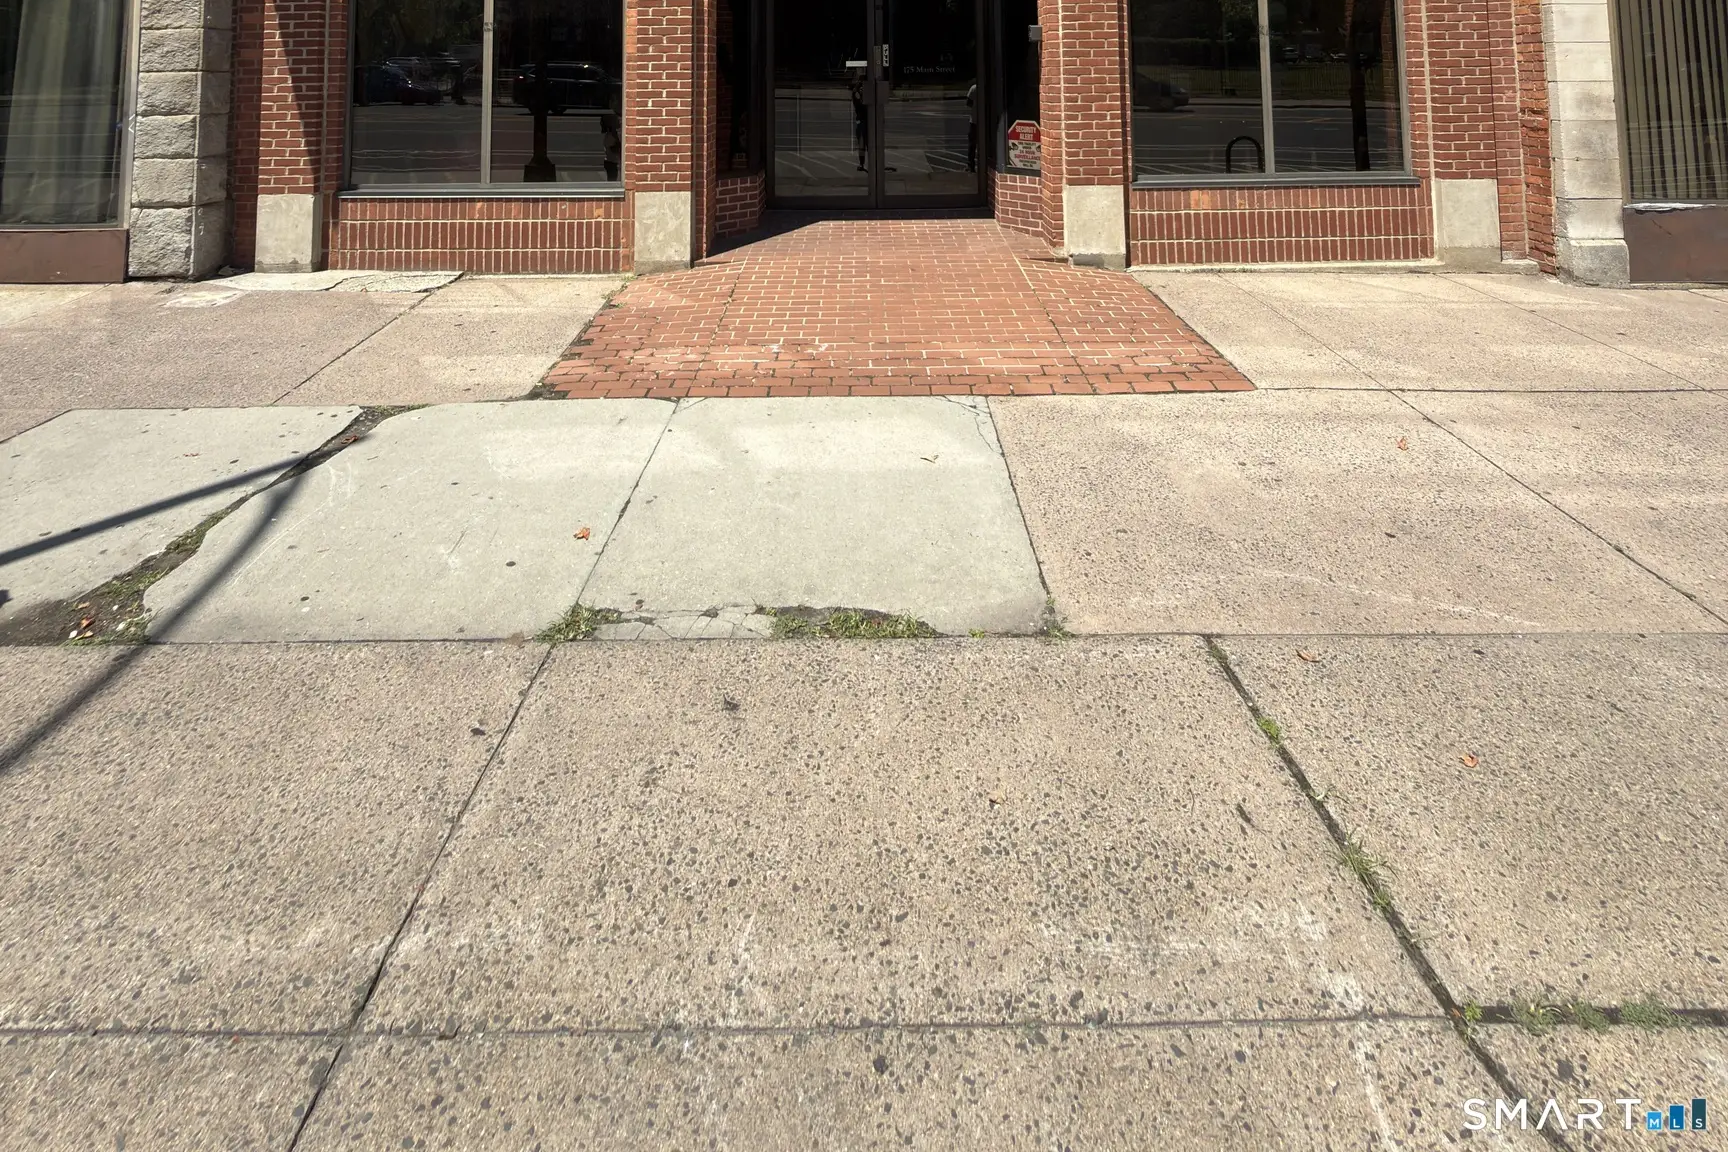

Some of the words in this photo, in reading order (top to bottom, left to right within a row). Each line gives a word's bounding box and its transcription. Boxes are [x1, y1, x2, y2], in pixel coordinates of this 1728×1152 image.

[903, 65, 915, 74] 175
[916, 65, 934, 74] Main
[935, 64, 956, 73] Street
